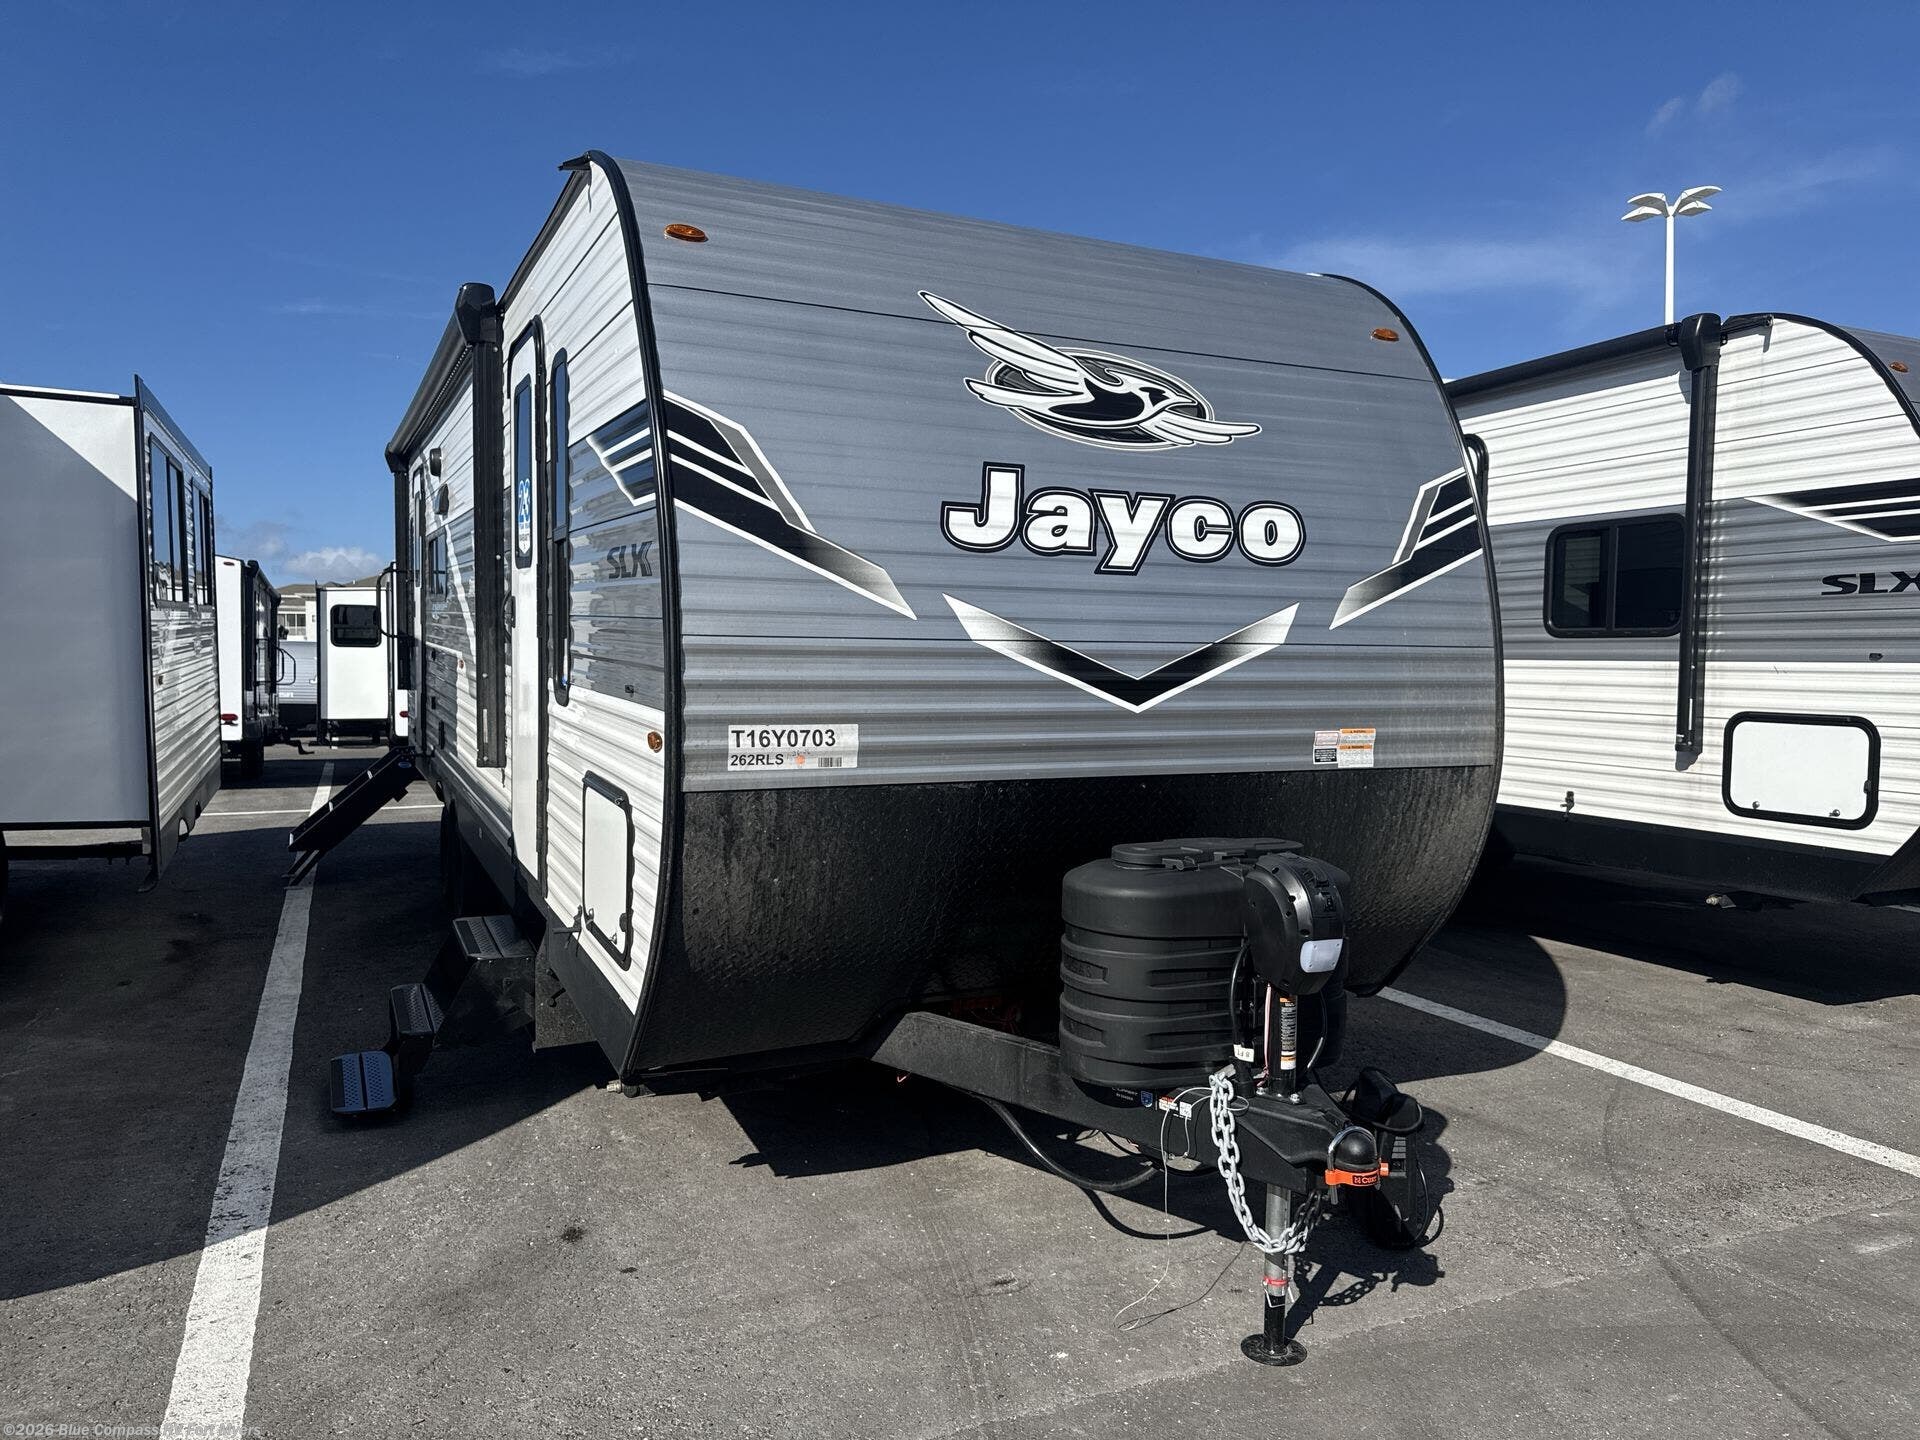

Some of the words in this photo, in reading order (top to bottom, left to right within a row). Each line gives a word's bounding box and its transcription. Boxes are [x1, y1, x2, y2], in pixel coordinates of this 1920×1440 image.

[940, 461, 1306, 576] Jayco
[1821, 571, 1920, 595] SLX
[731, 729, 836, 748] T16Y0703
[730, 753, 784, 766] 262RLS
